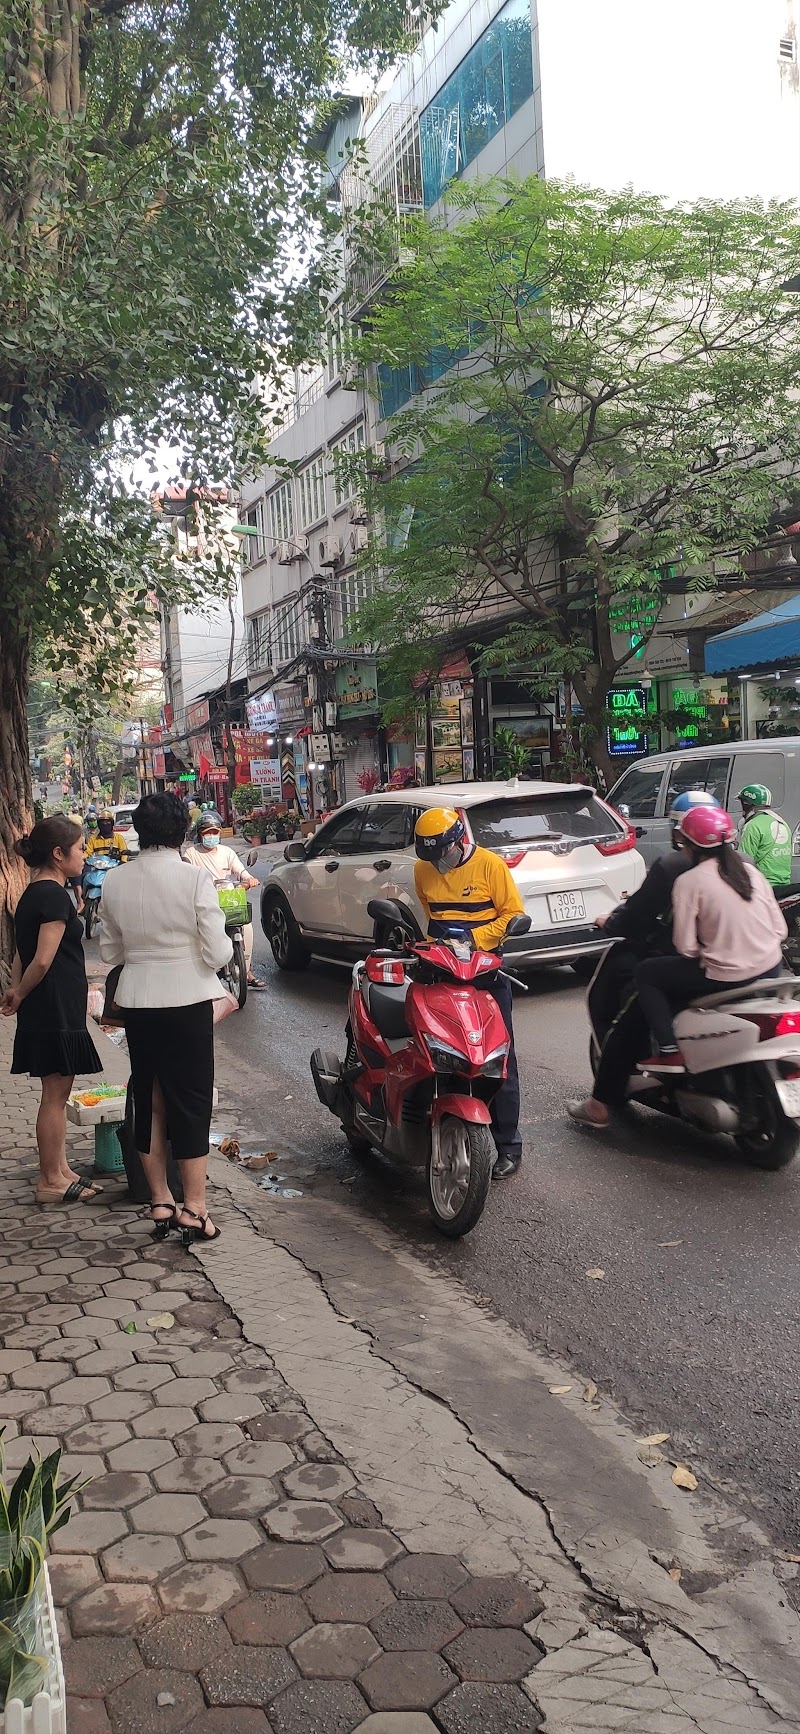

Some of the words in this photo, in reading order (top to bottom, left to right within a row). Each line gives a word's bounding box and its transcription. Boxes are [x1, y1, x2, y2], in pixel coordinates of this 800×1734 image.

[743, 790, 756, 799] Grab
[423, 838, 437, 847] be
[772, 846, 791, 857] Grab
[557, 893, 576, 906] 30G
